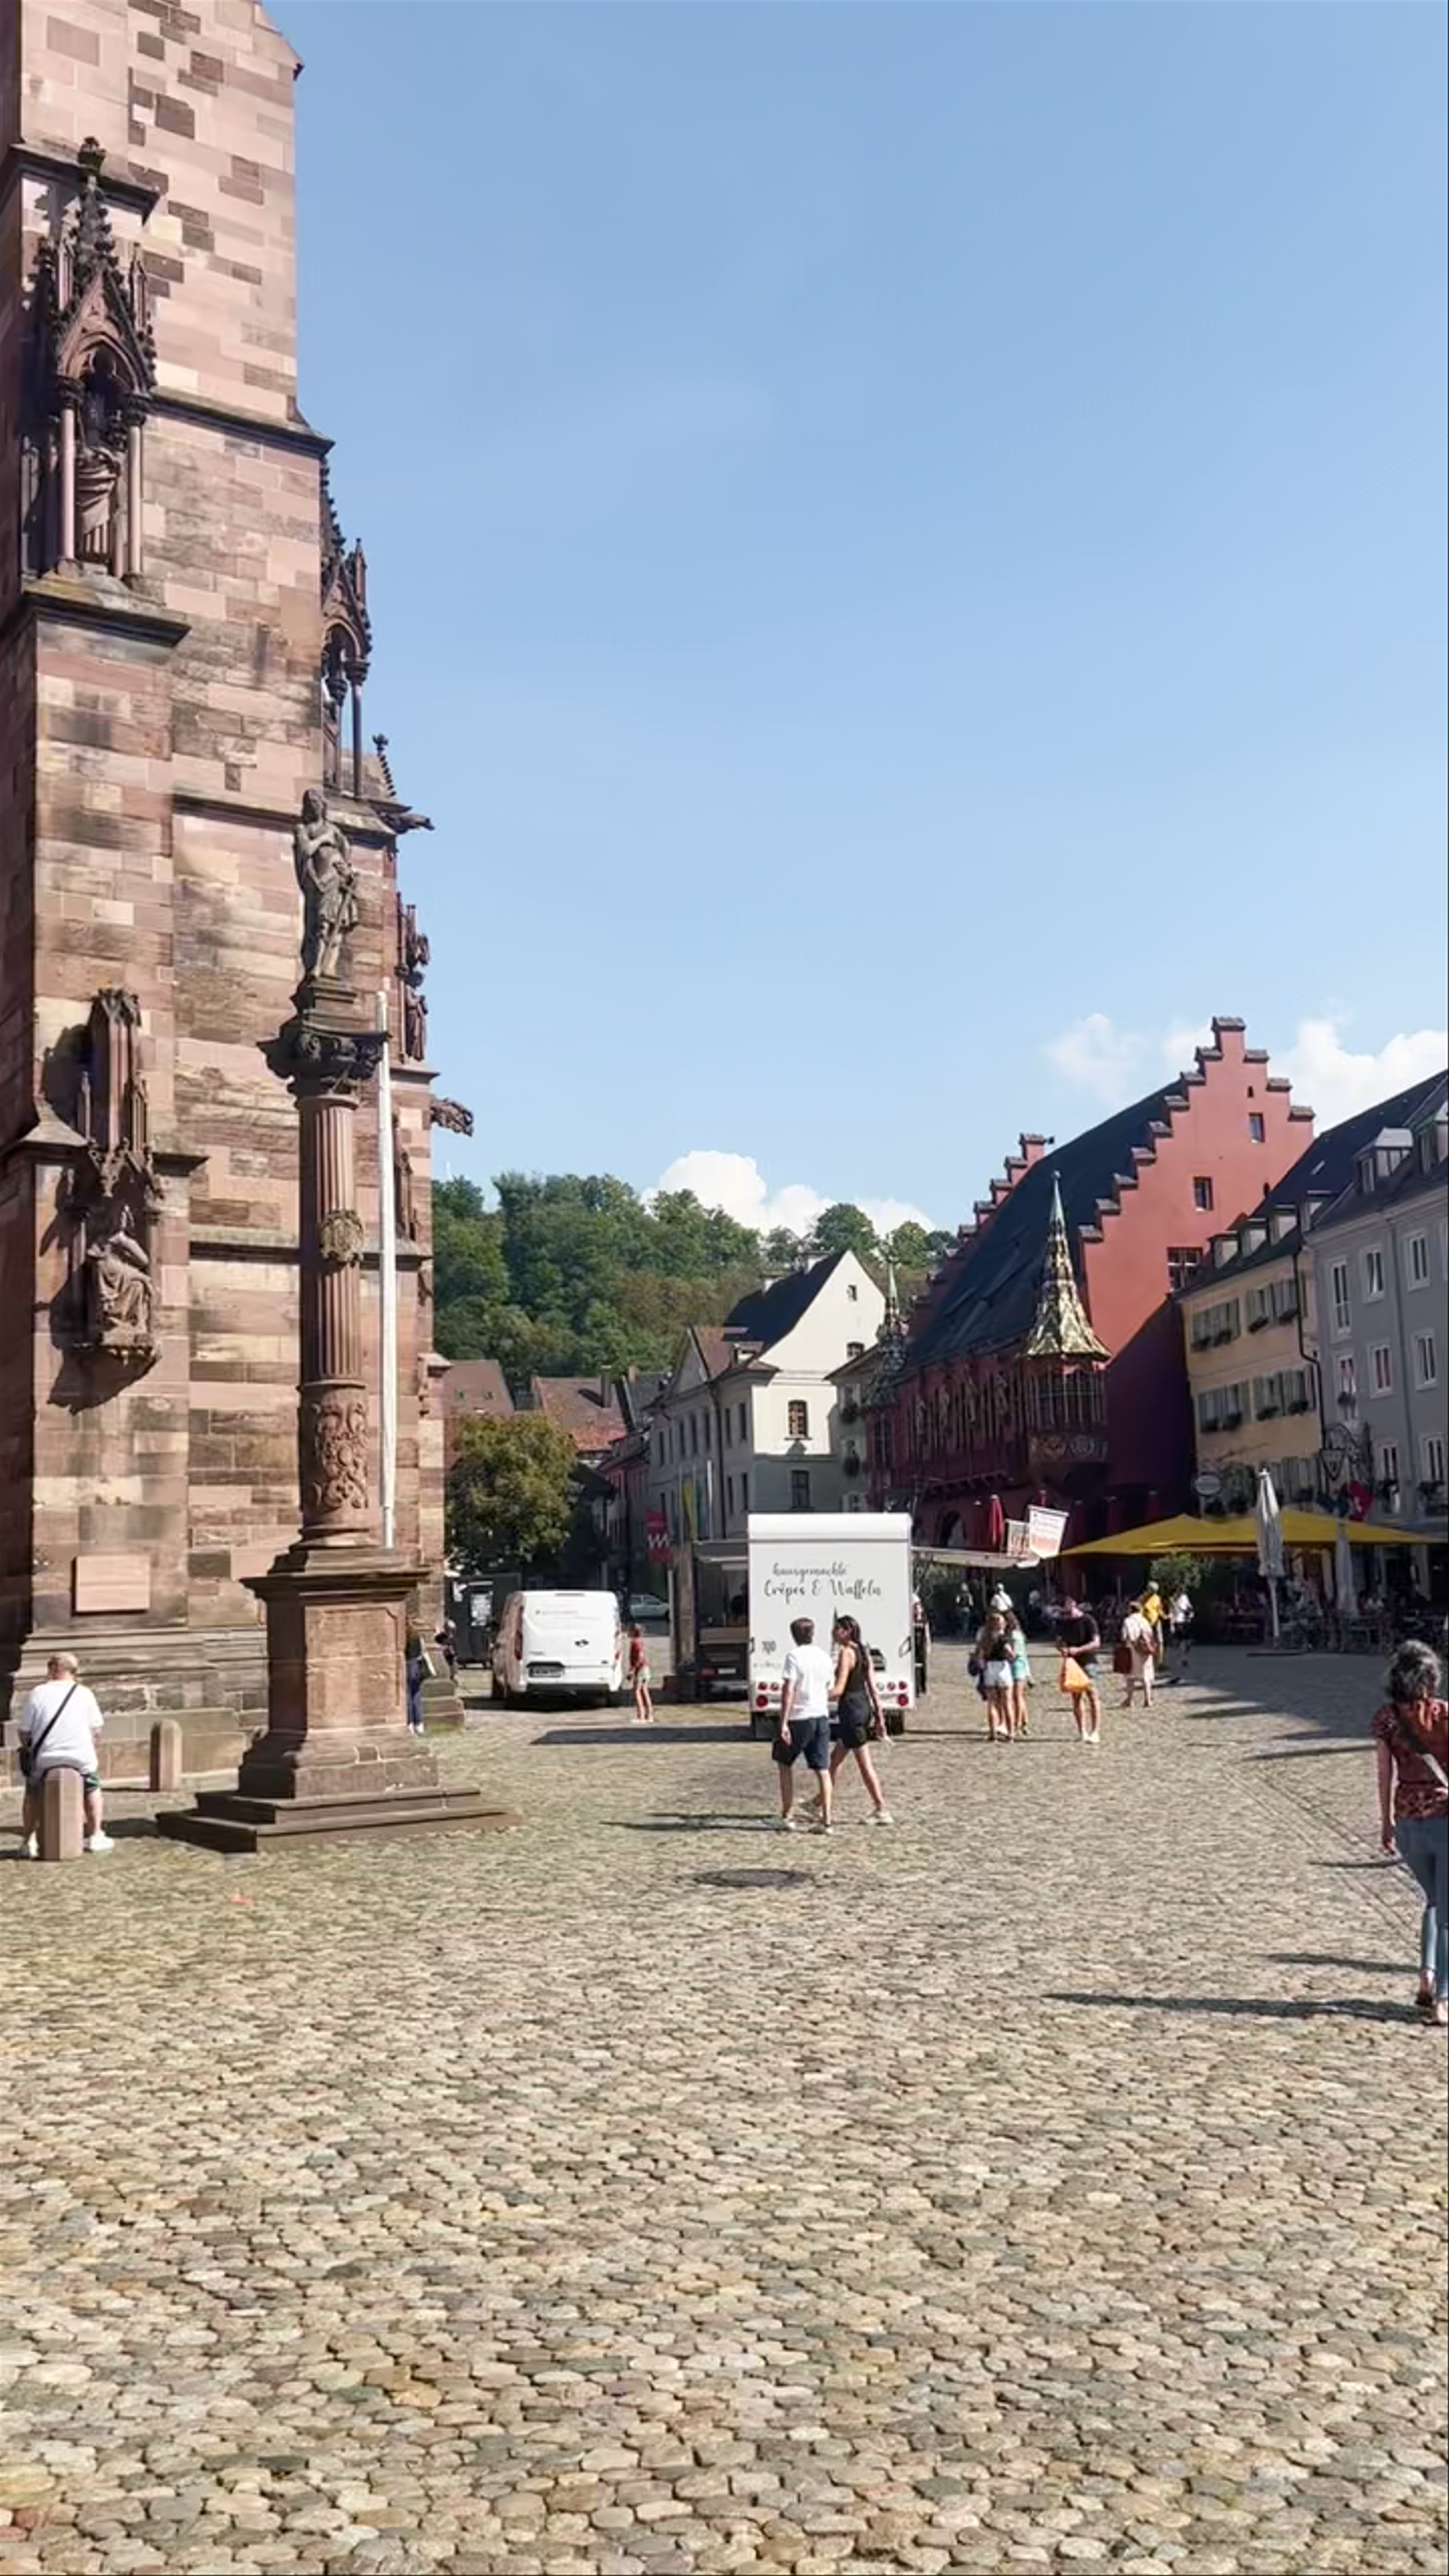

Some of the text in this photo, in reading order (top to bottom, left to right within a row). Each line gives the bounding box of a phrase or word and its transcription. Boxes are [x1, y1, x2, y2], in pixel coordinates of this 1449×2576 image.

[764, 1578, 881, 1604] Crêpes & Waffeln
